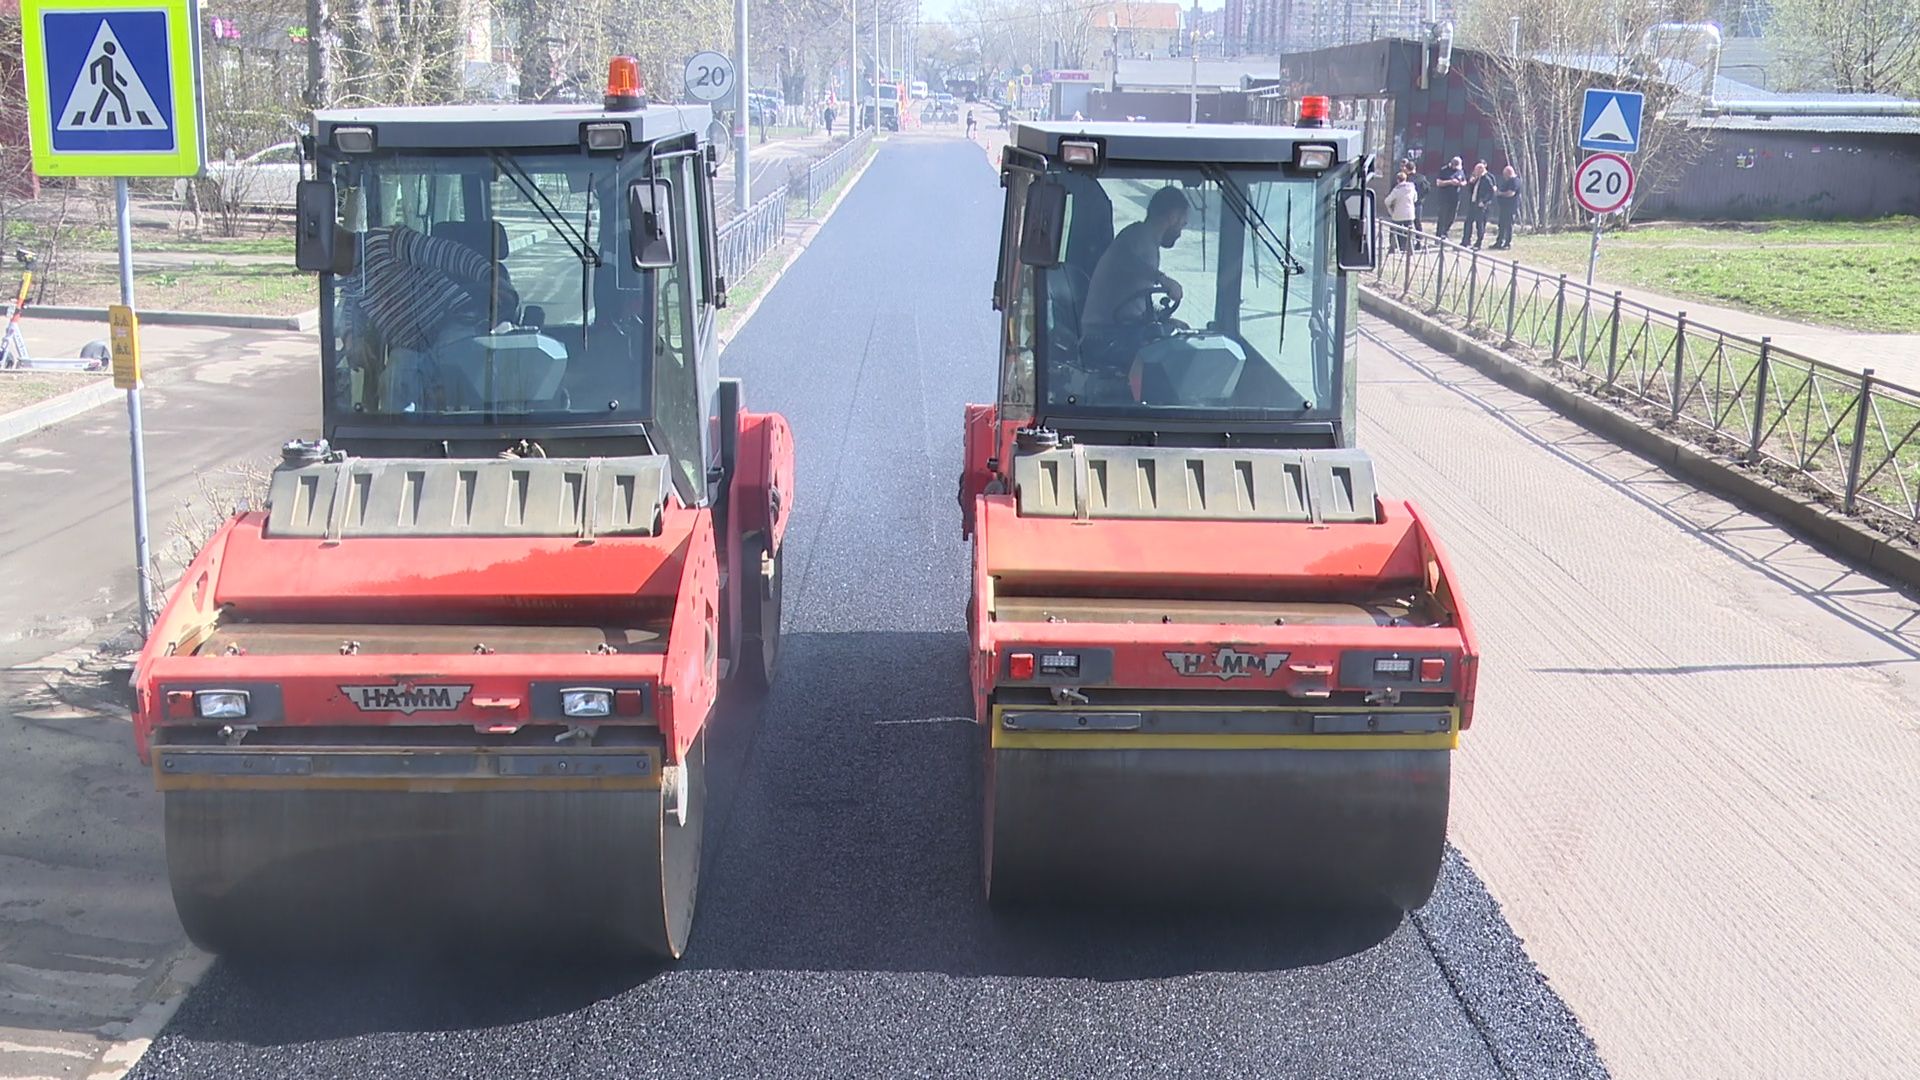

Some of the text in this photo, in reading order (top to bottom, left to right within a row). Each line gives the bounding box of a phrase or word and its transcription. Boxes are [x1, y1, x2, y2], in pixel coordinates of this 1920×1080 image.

[697, 66, 725, 87] 20
[1585, 170, 1621, 195] 20
[362, 688, 452, 707] HAMM
